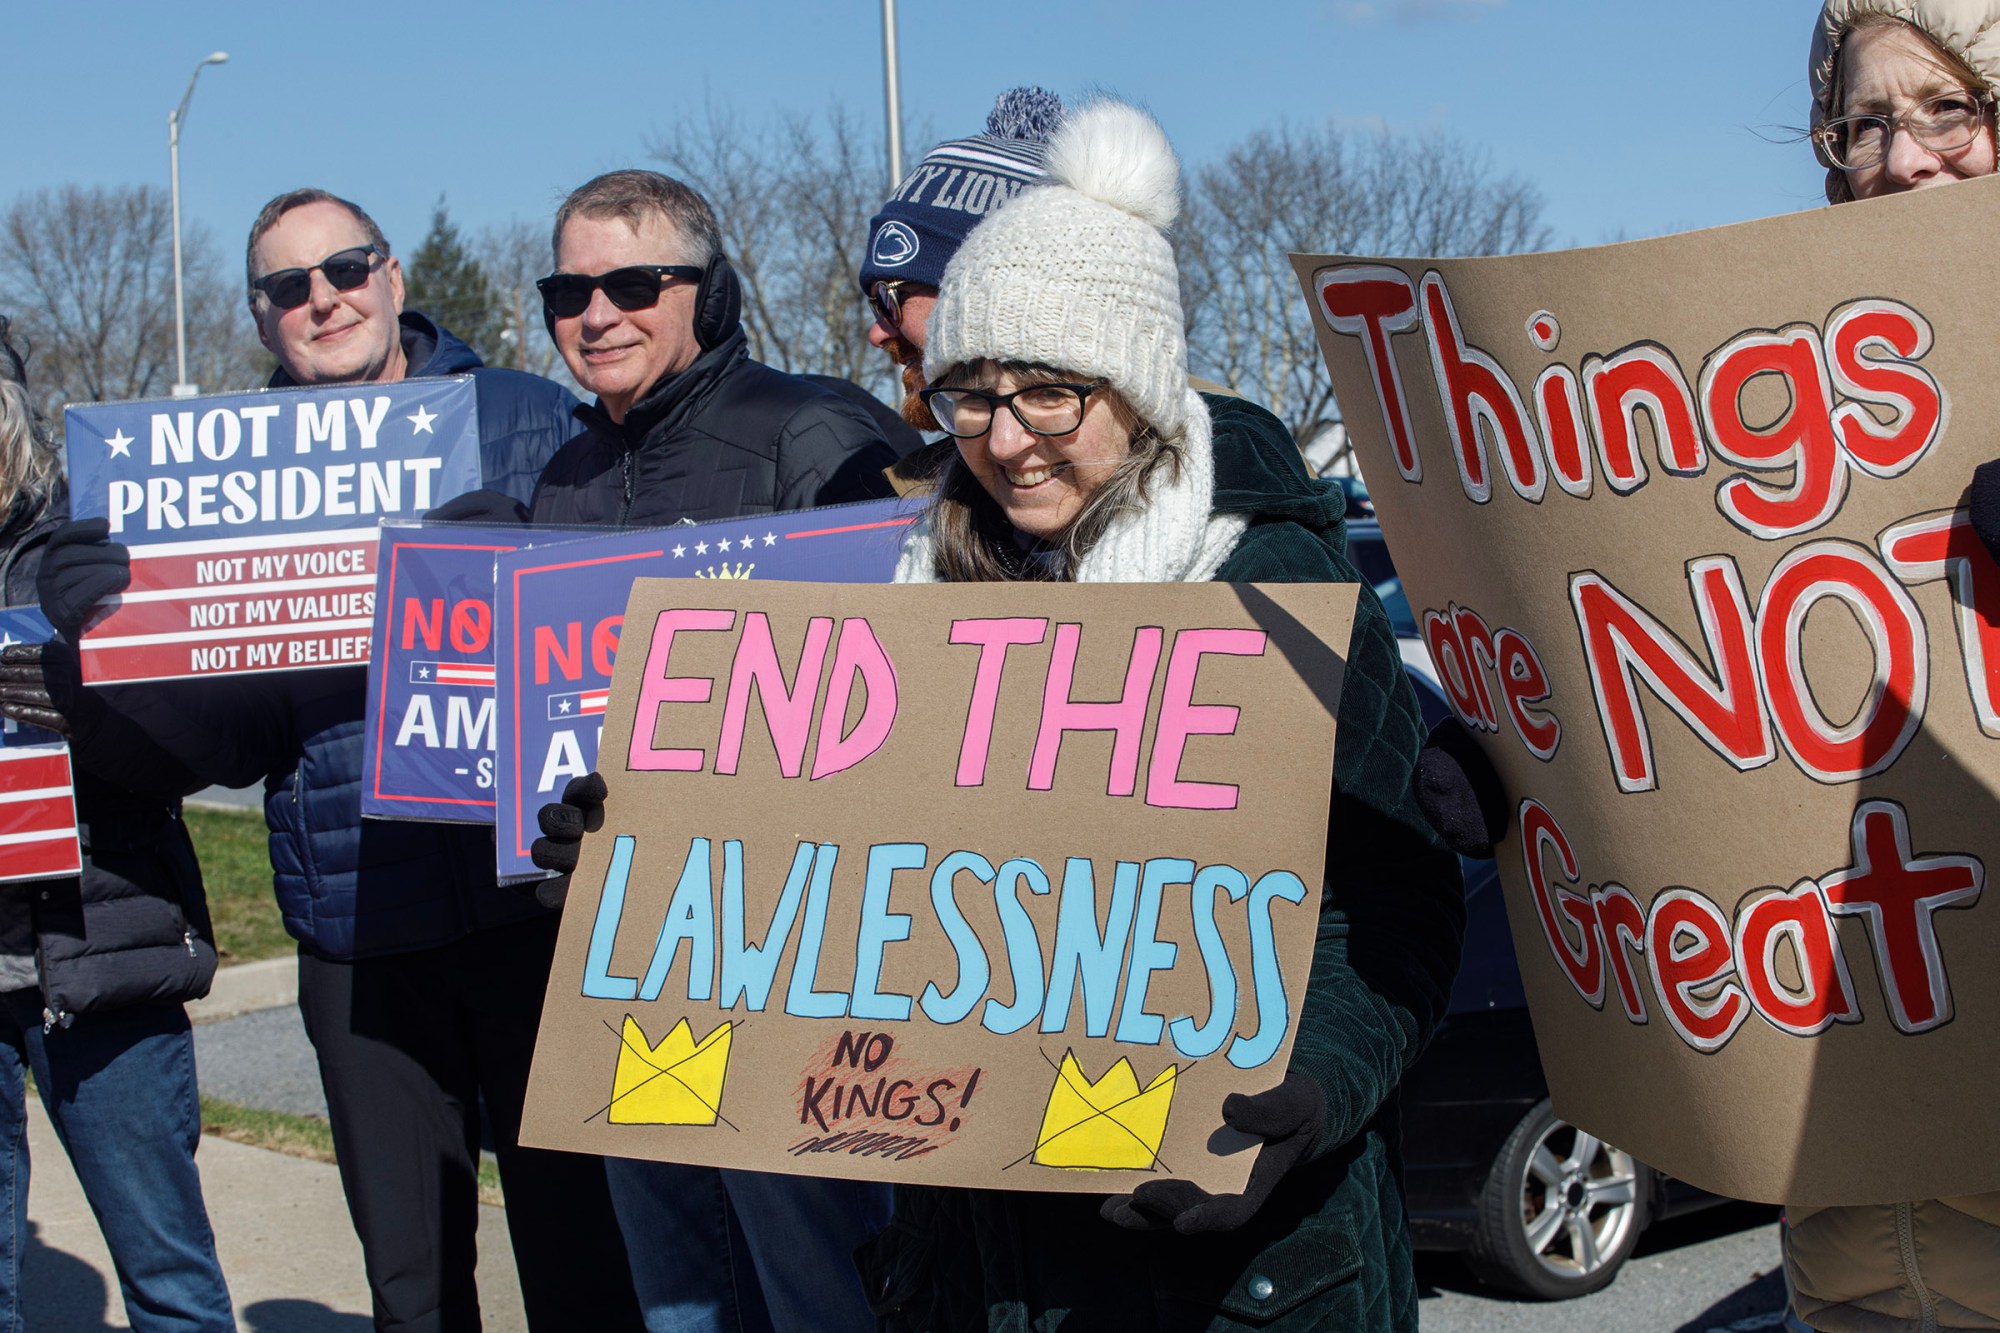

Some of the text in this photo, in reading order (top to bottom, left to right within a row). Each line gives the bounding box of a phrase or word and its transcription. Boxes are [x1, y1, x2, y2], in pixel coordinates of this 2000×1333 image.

[151, 396, 392, 465] NOT MY
[1311, 262, 1942, 541] Things
[109, 457, 442, 533] PRESIDENT
[196, 549, 366, 584] NOT MY VOICE
[190, 592, 376, 628] NOT MY VALUES
[191, 646, 241, 671] NOT
[246, 642, 284, 667] MY
[1422, 602, 1562, 762] are
[626, 608, 1269, 809] END THE
[582, 834, 1308, 1069] LAWLESSNESS
[1519, 798, 1984, 1054] Great
[831, 1031, 894, 1072] NO
[801, 1068, 981, 1132] KINGS!
